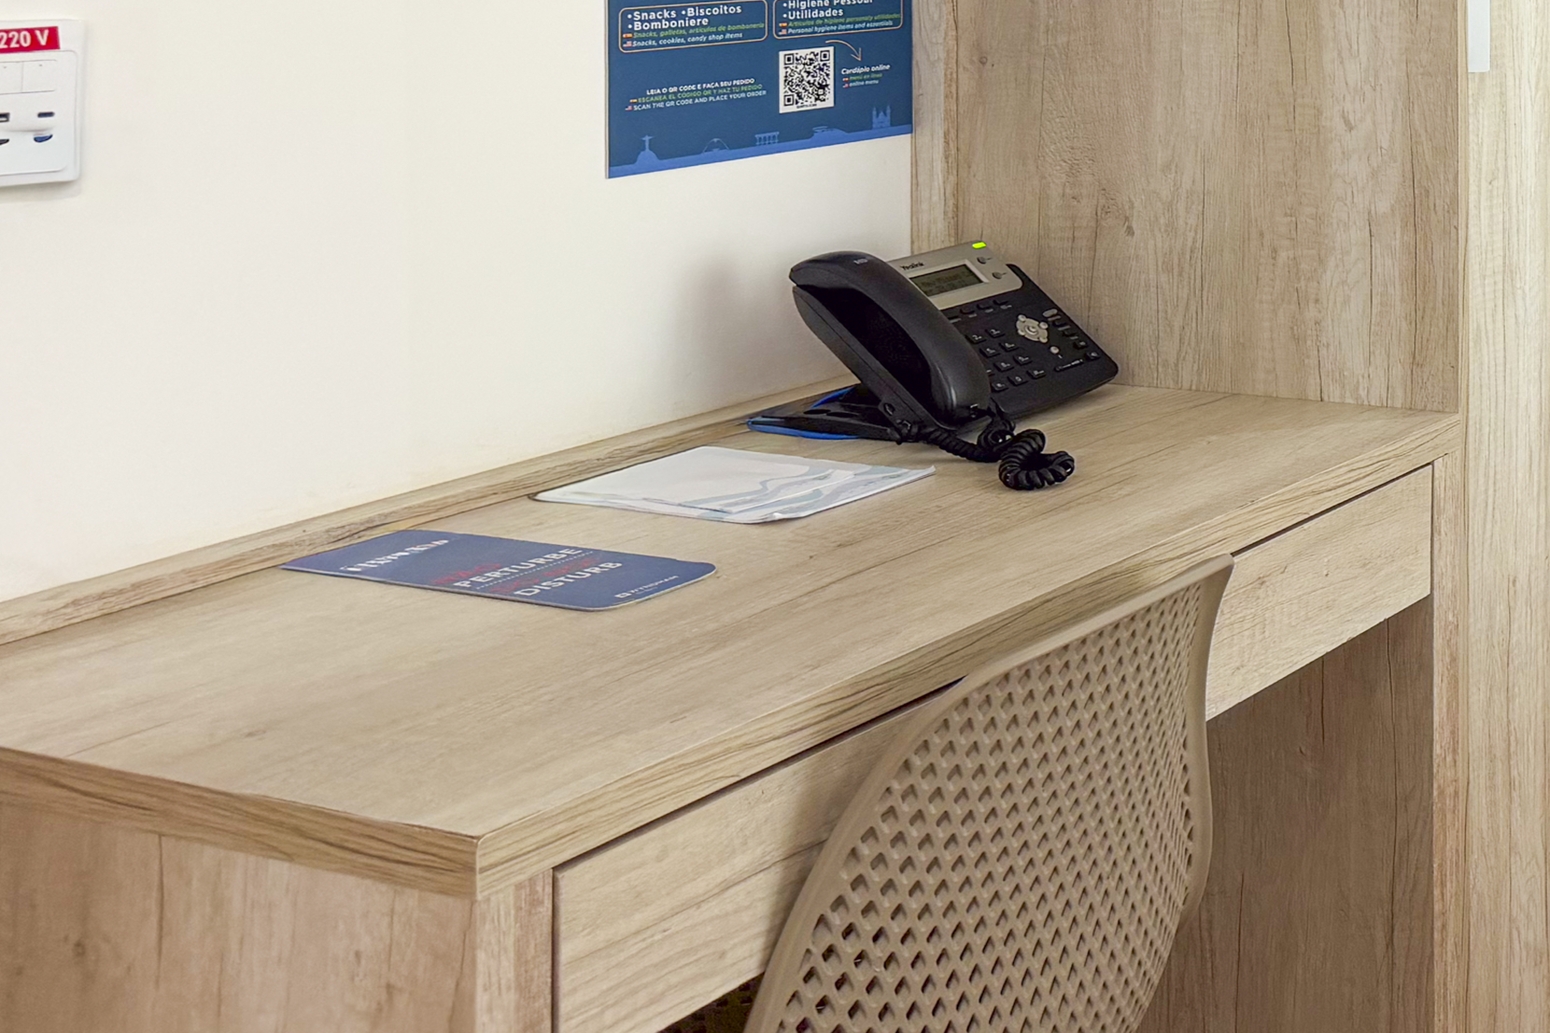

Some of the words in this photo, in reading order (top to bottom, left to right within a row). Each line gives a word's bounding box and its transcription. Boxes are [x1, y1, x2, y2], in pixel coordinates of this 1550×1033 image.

[633, 9, 677, 21] Snacks
[788, 8, 844, 20] Utilidades
[633, 17, 709, 32] Bomboniere
[0, 29, 32, 49] 220
[34, 28, 50, 47] V
[871, 64, 891, 72] online
[453, 548, 583, 588] PERTURBE
[513, 561, 623, 597] DISTURB
